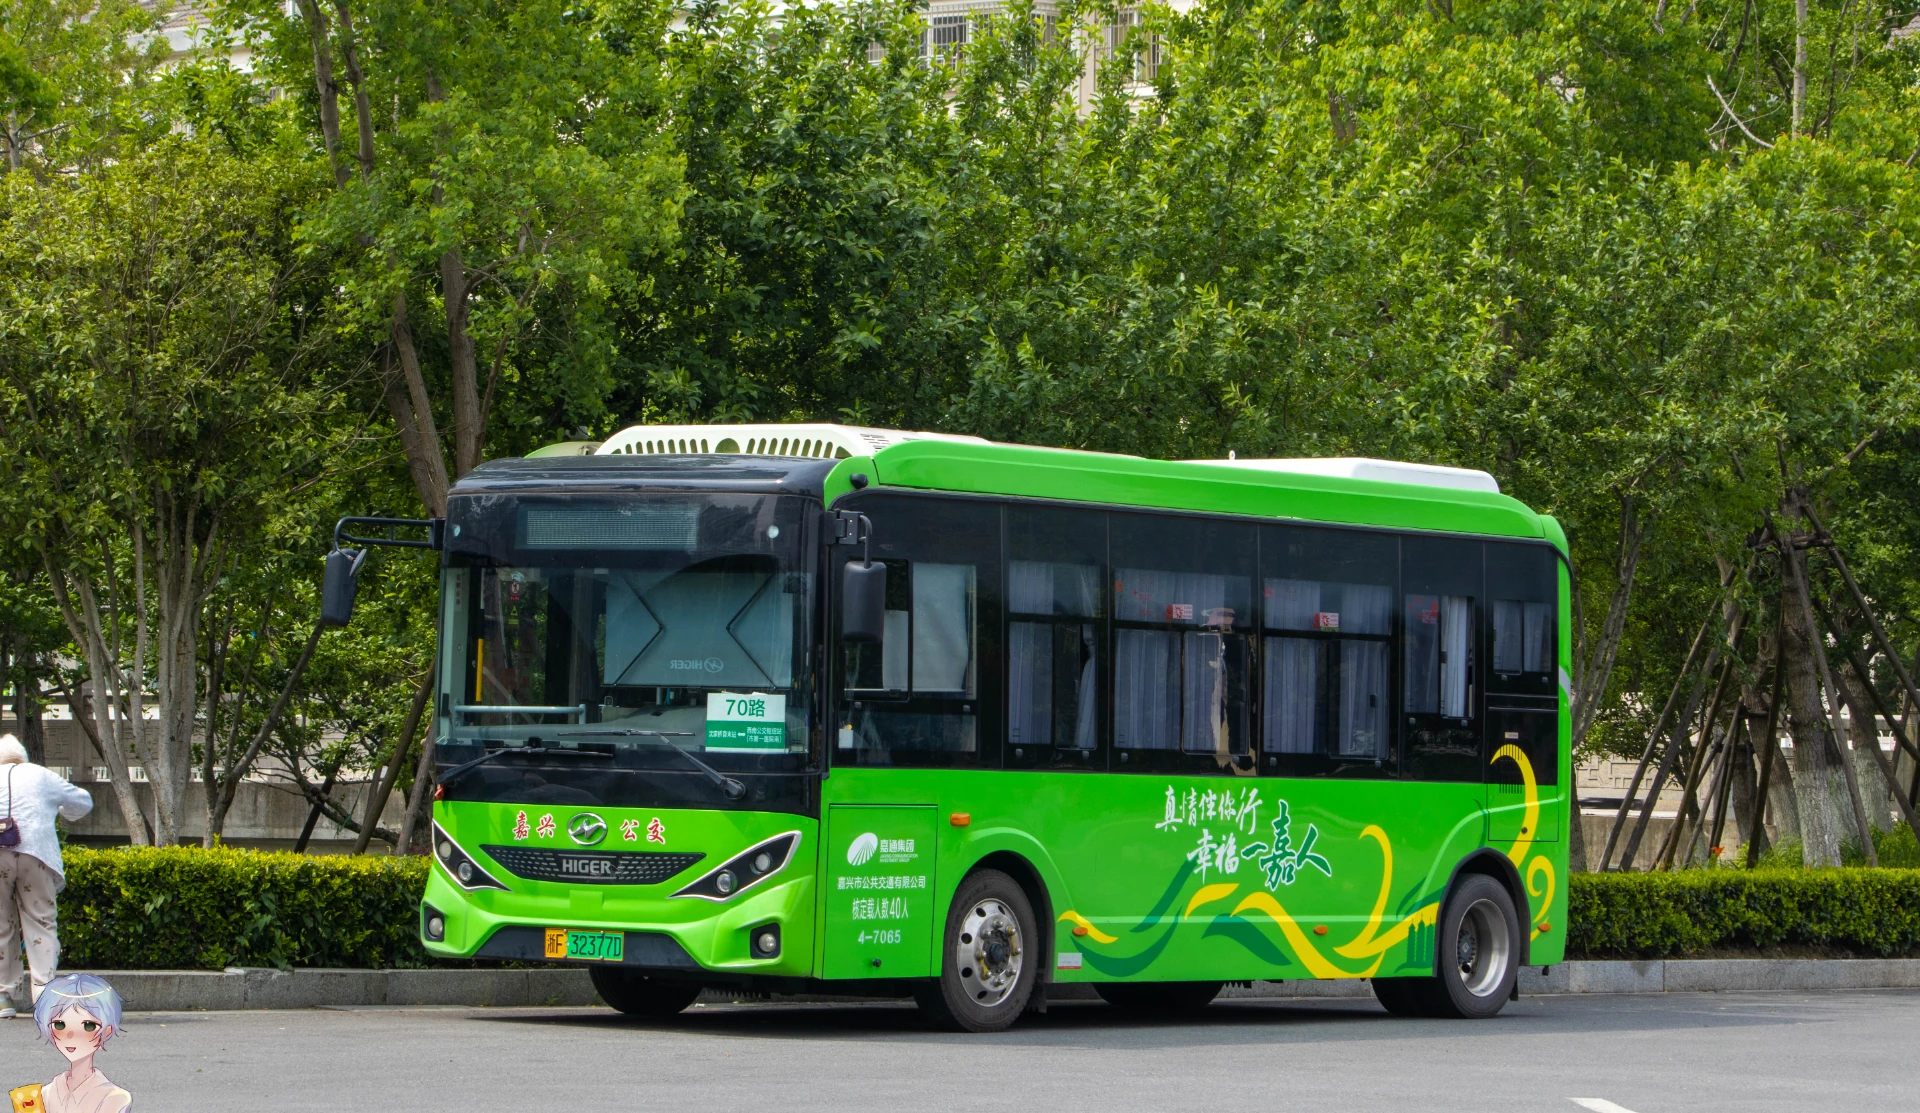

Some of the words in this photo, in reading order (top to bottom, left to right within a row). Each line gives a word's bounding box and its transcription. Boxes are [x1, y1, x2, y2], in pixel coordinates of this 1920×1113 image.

[725, 699, 766, 717] 70路
[1155, 785, 1263, 834] 真情伴你行
[512, 810, 557, 840] 嘉兴
[620, 817, 666, 844] 公交
[880, 839, 914, 853] 嘉通集团
[1187, 799, 1332, 892] 幸福一嘉人
[562, 858, 611, 875] HIGER
[837, 876, 926, 890] 嘉兴市公共交通有限公司
[852, 897, 909, 920] 核定载人数40人
[858, 930, 901, 944] 4-7065
